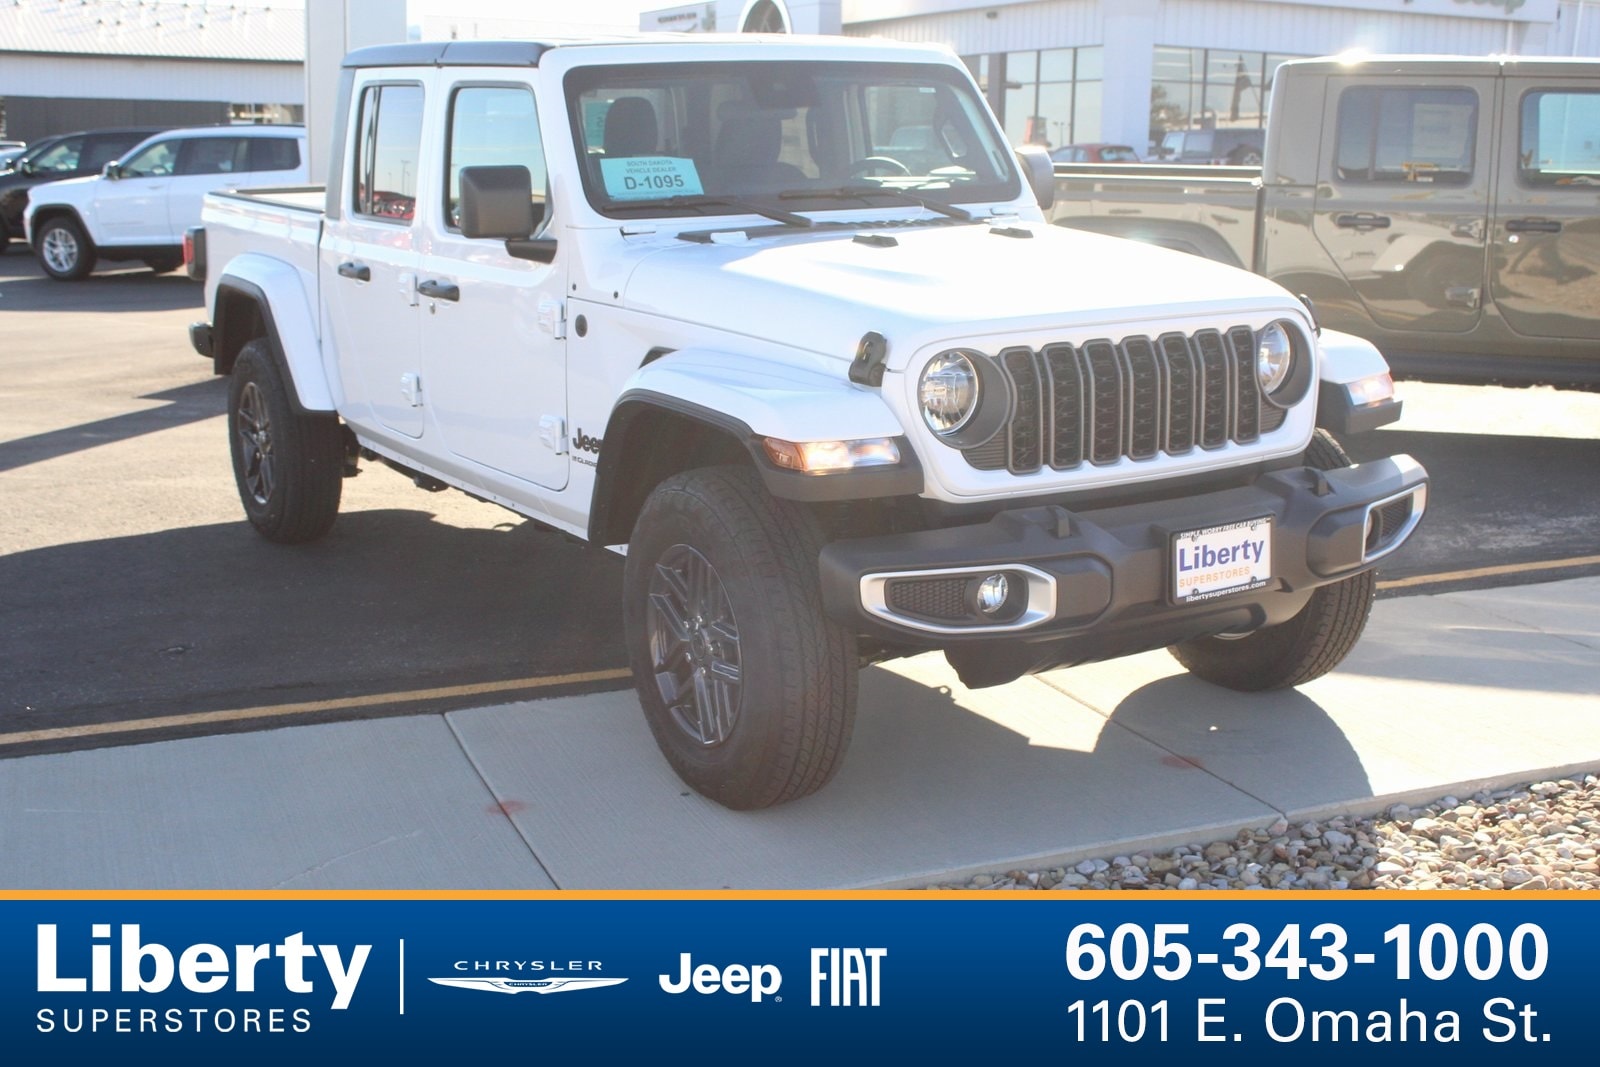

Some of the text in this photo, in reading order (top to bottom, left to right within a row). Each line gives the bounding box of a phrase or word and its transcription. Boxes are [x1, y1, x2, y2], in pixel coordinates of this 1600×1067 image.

[624, 174, 685, 190] D-1095
[1179, 539, 1264, 572] Liberty
[1179, 566, 1250, 588] SUPERSTORES
[1186, 580, 1267, 602] libertysuperstores.com
